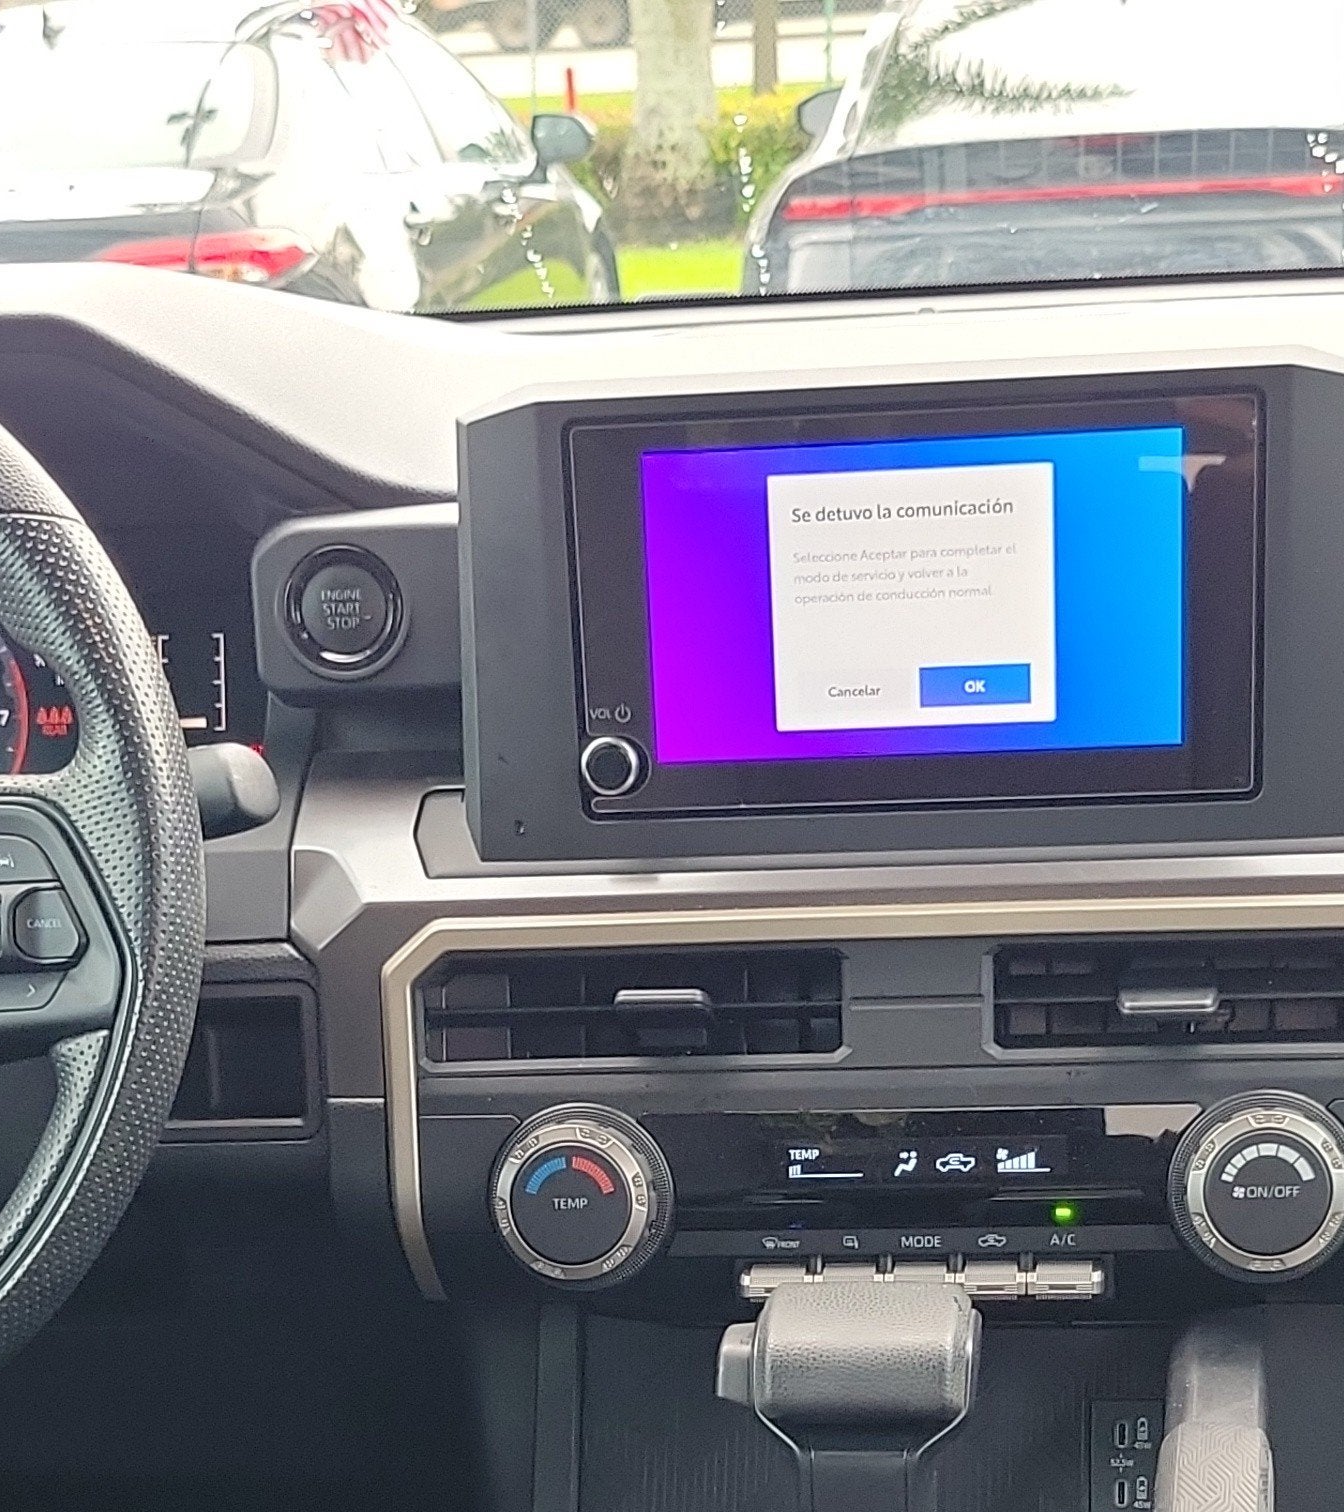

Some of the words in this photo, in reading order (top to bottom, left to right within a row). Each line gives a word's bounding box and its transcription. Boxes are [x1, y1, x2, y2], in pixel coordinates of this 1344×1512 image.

[791, 507, 811, 523] Se
[814, 506, 873, 522] detuvo
[876, 503, 892, 519] la
[896, 498, 1014, 518] comunicación
[793, 550, 857, 564] Seleccione
[860, 550, 907, 563] Aceptar
[910, 548, 937, 561] para
[940, 544, 1002, 559] completar
[1005, 543, 1017, 555] el
[793, 573, 830, 584] modo
[832, 571, 849, 582] de
[851, 569, 896, 581] servicio
[898, 570, 906, 582] y
[908, 566, 944, 579] volver
[946, 569, 955, 577] a
[956, 565, 968, 577] la
[321, 588, 360, 600] ENGINE
[794, 591, 854, 605] operación
[857, 589, 873, 601] de
[875, 587, 946, 600] conducción
[322, 602, 360, 615] START
[327, 616, 360, 629] STOP
[828, 684, 881, 698] Cancelar
[964, 679, 986, 693] OK
[589, 707, 612, 719] VOL
[27, 918, 62, 929] CANCEL
[789, 1149, 820, 1160] TEMP
[1246, 1185, 1300, 1198] ON/OFF
[553, 1198, 588, 1210] TEMP
[901, 1236, 942, 1247] MODE
[1050, 1234, 1075, 1247] A/C
